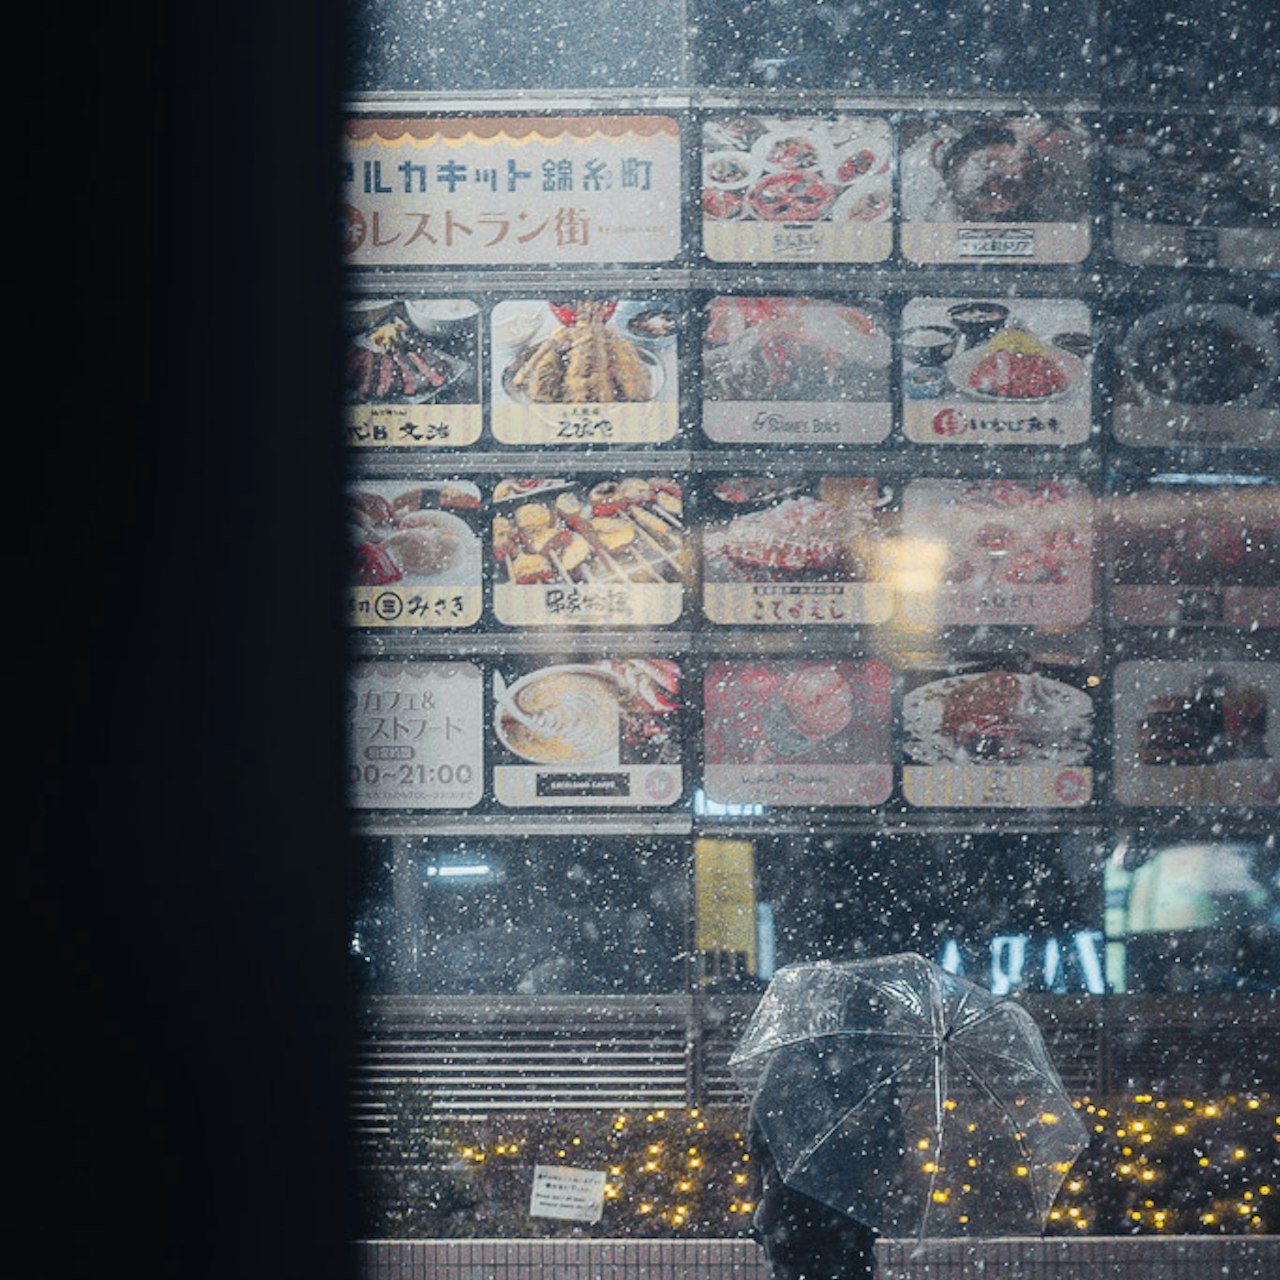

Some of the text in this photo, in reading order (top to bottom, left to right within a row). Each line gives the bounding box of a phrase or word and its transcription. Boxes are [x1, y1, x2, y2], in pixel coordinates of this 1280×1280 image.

[372, 207, 590, 247] レストラン街
